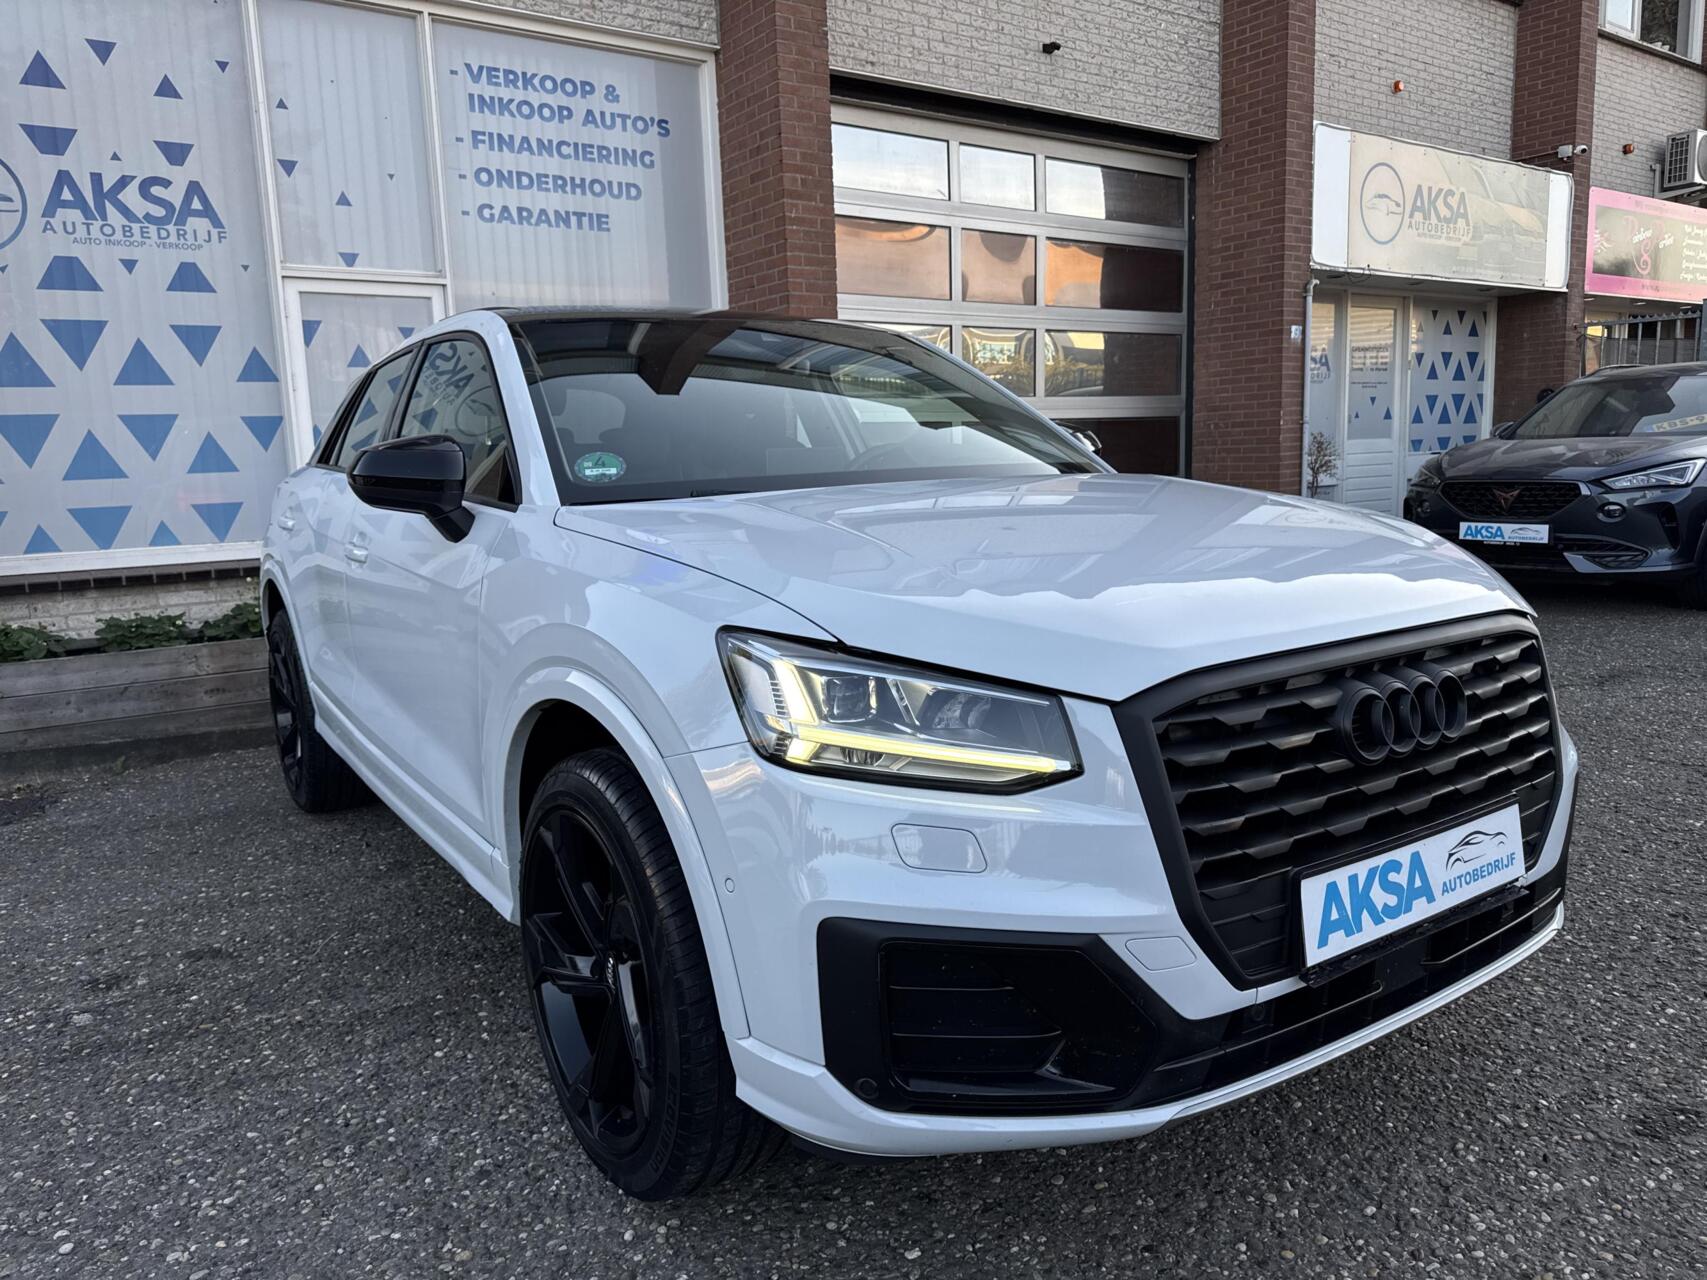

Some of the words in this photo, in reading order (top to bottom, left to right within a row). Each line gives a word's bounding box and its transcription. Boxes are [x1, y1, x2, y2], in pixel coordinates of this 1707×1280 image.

[464, 62, 596, 99] VERKOOP
[603, 84, 620, 104] &
[468, 93, 574, 124] INKOOP
[581, 108, 671, 138] AUTO'S
[471, 129, 655, 169] FINANCIERING
[41, 169, 226, 229] AKSA
[474, 166, 642, 201] ONDERHOUD
[477, 203, 611, 232] GARANTIE
[1408, 184, 1471, 227] AKSA
[42, 220, 228, 243] AUTOBEDRIJF
[72, 236, 103, 246] AUTO
[105, 238, 146, 248] INKOOP
[155, 241, 204, 251] VERKOOP
[1407, 221, 1471, 239] AUTOBEDRIJF
[1463, 525, 1505, 539] AKSA
[1441, 852, 1516, 896] AUTOBEDRIJF
[1317, 850, 1436, 949] AKSA
